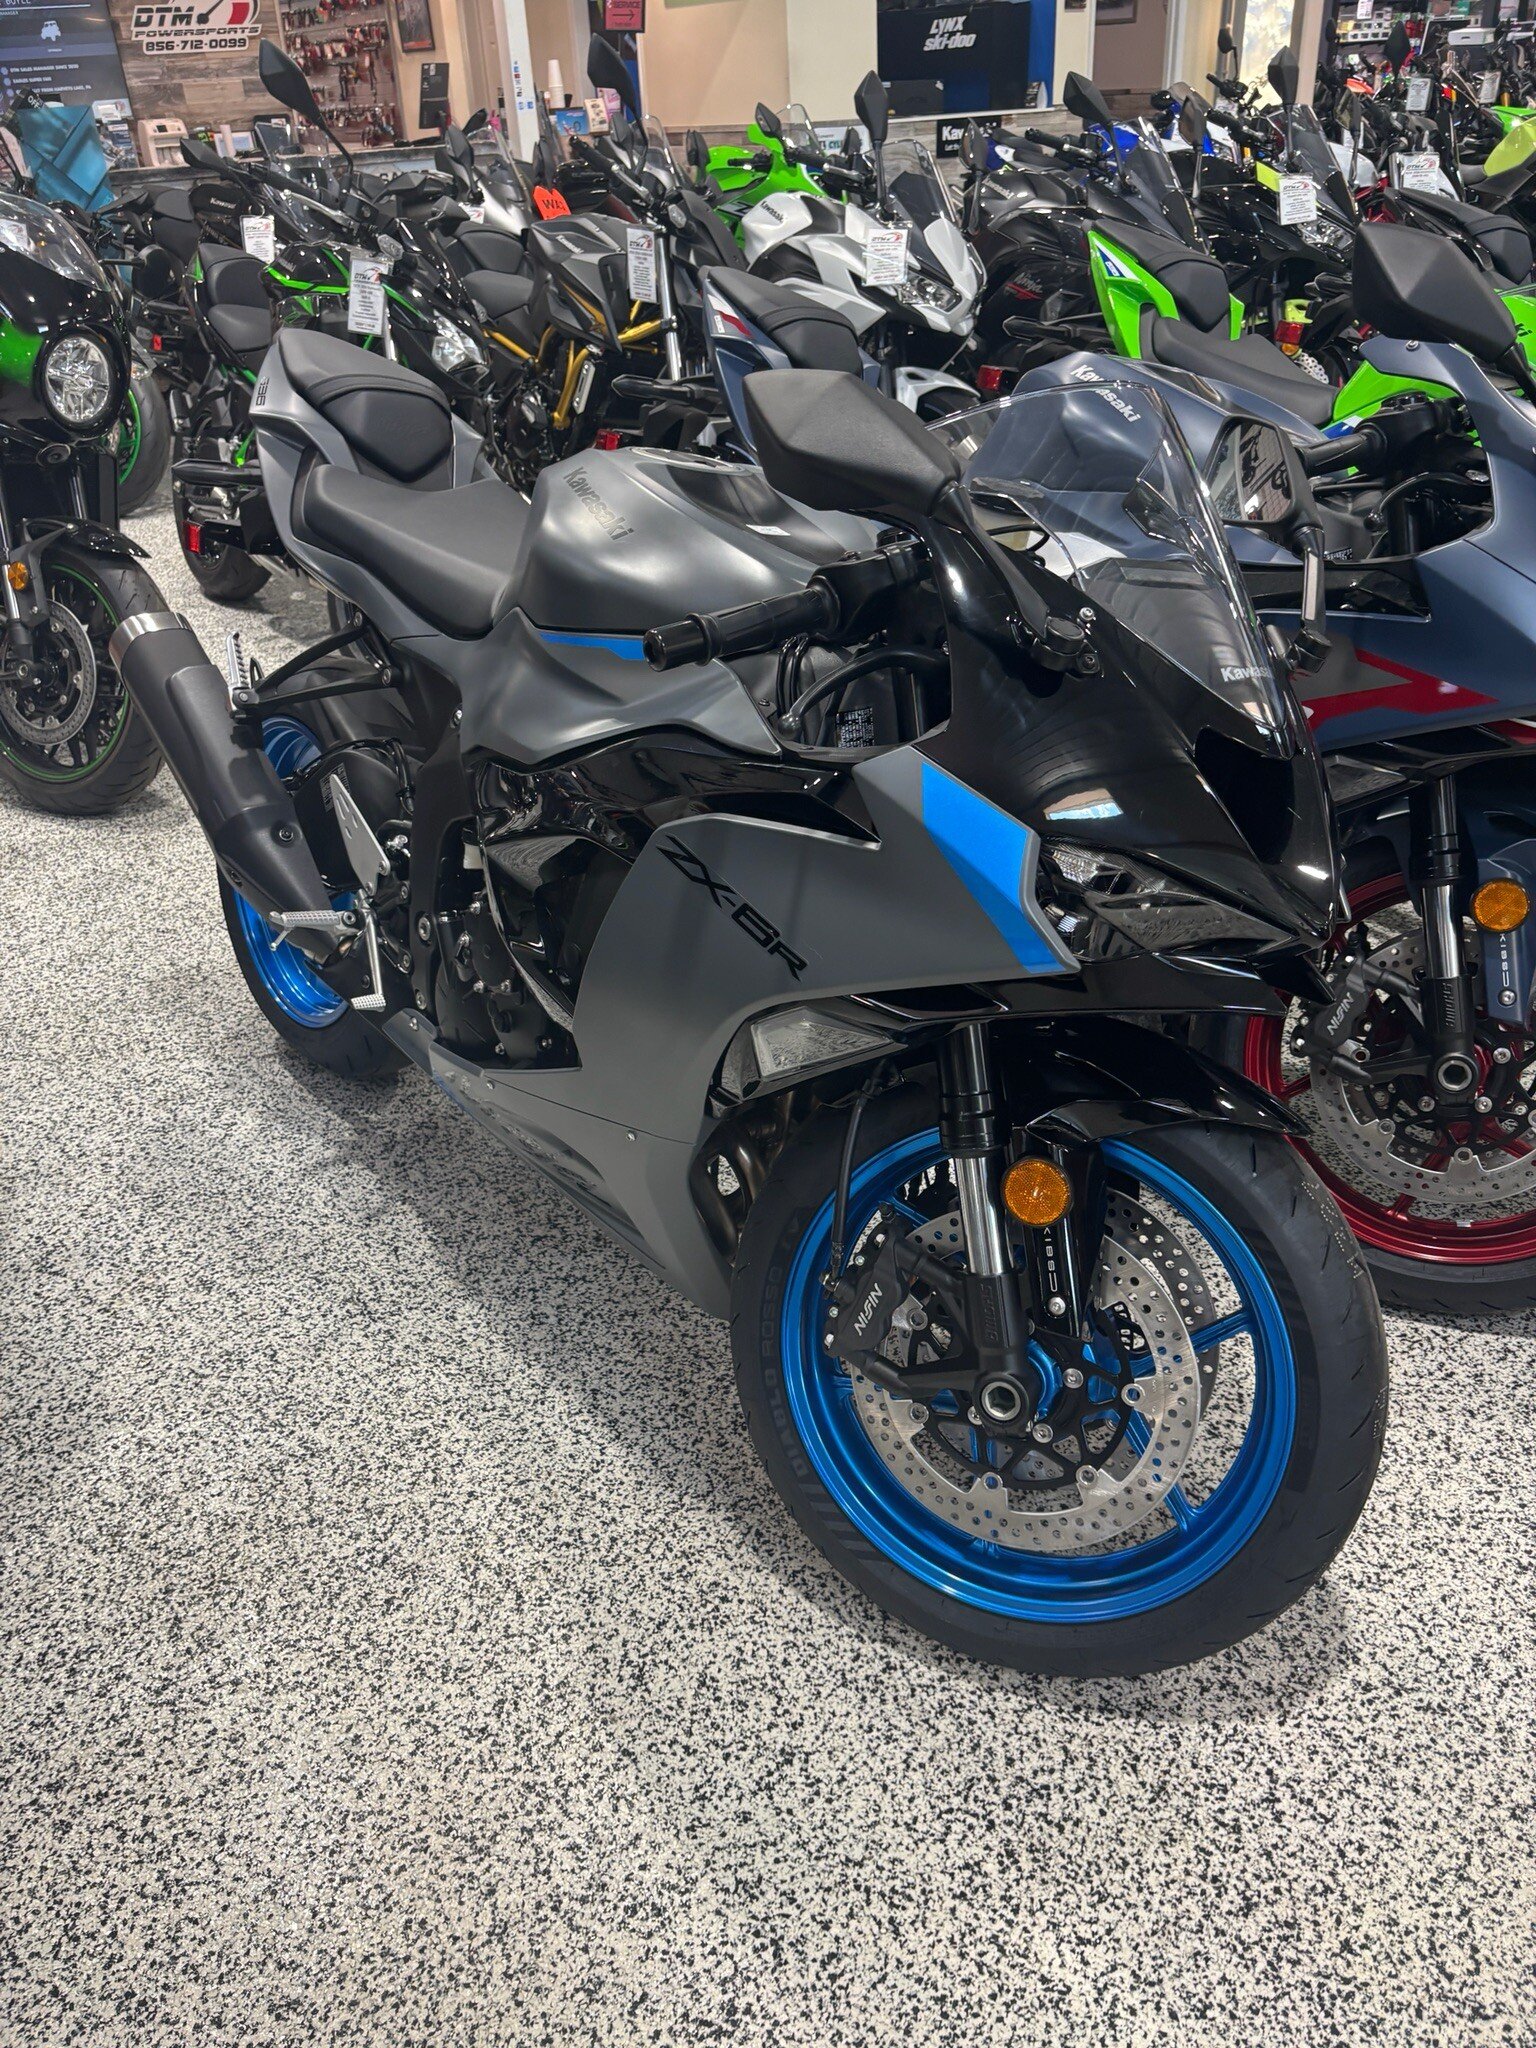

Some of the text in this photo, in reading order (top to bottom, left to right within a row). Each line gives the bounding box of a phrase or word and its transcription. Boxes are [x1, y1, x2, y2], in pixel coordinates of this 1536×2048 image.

[134, 5, 195, 28] DTM
[929, 15, 967, 34] LYNX
[134, 26, 260, 38] POWERSPORTS
[923, 32, 976, 51] ski-doo
[146, 38, 247, 52] 856-712-0099
[1070, 364, 1142, 423] Kawasaki
[563, 466, 634, 541] Kawasaki
[1220, 666, 1273, 683] Kawas
[655, 833, 809, 983] ZX-6R
[853, 1281, 884, 1337] NISSIN
